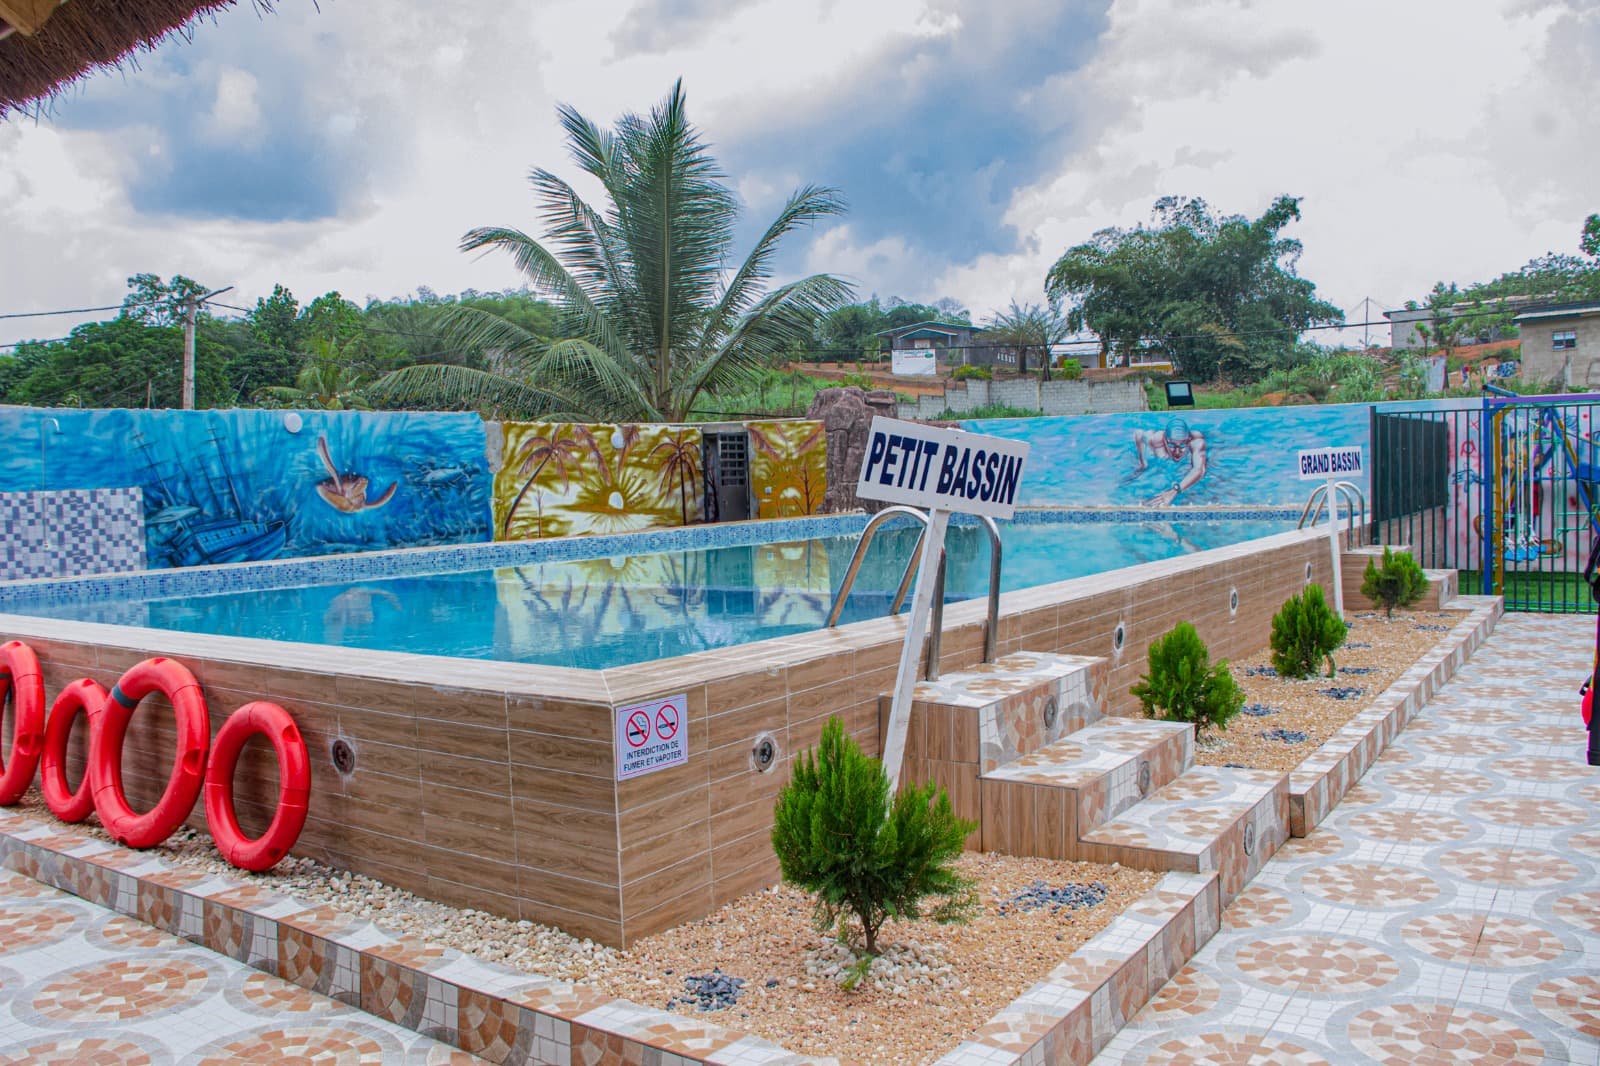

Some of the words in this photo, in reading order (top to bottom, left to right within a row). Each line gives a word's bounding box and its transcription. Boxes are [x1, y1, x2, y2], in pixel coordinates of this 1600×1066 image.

[864, 432, 940, 491] PETIT
[936, 445, 1023, 505] BASSIN
[1301, 454, 1329, 475] GRAND
[1331, 451, 1361, 472] BASSIN
[624, 760, 645, 771] FUMER
[646, 756, 653, 766] ET
[655, 750, 682, 762] VAPOTER
[626, 744, 670, 760] INTERDICTION
